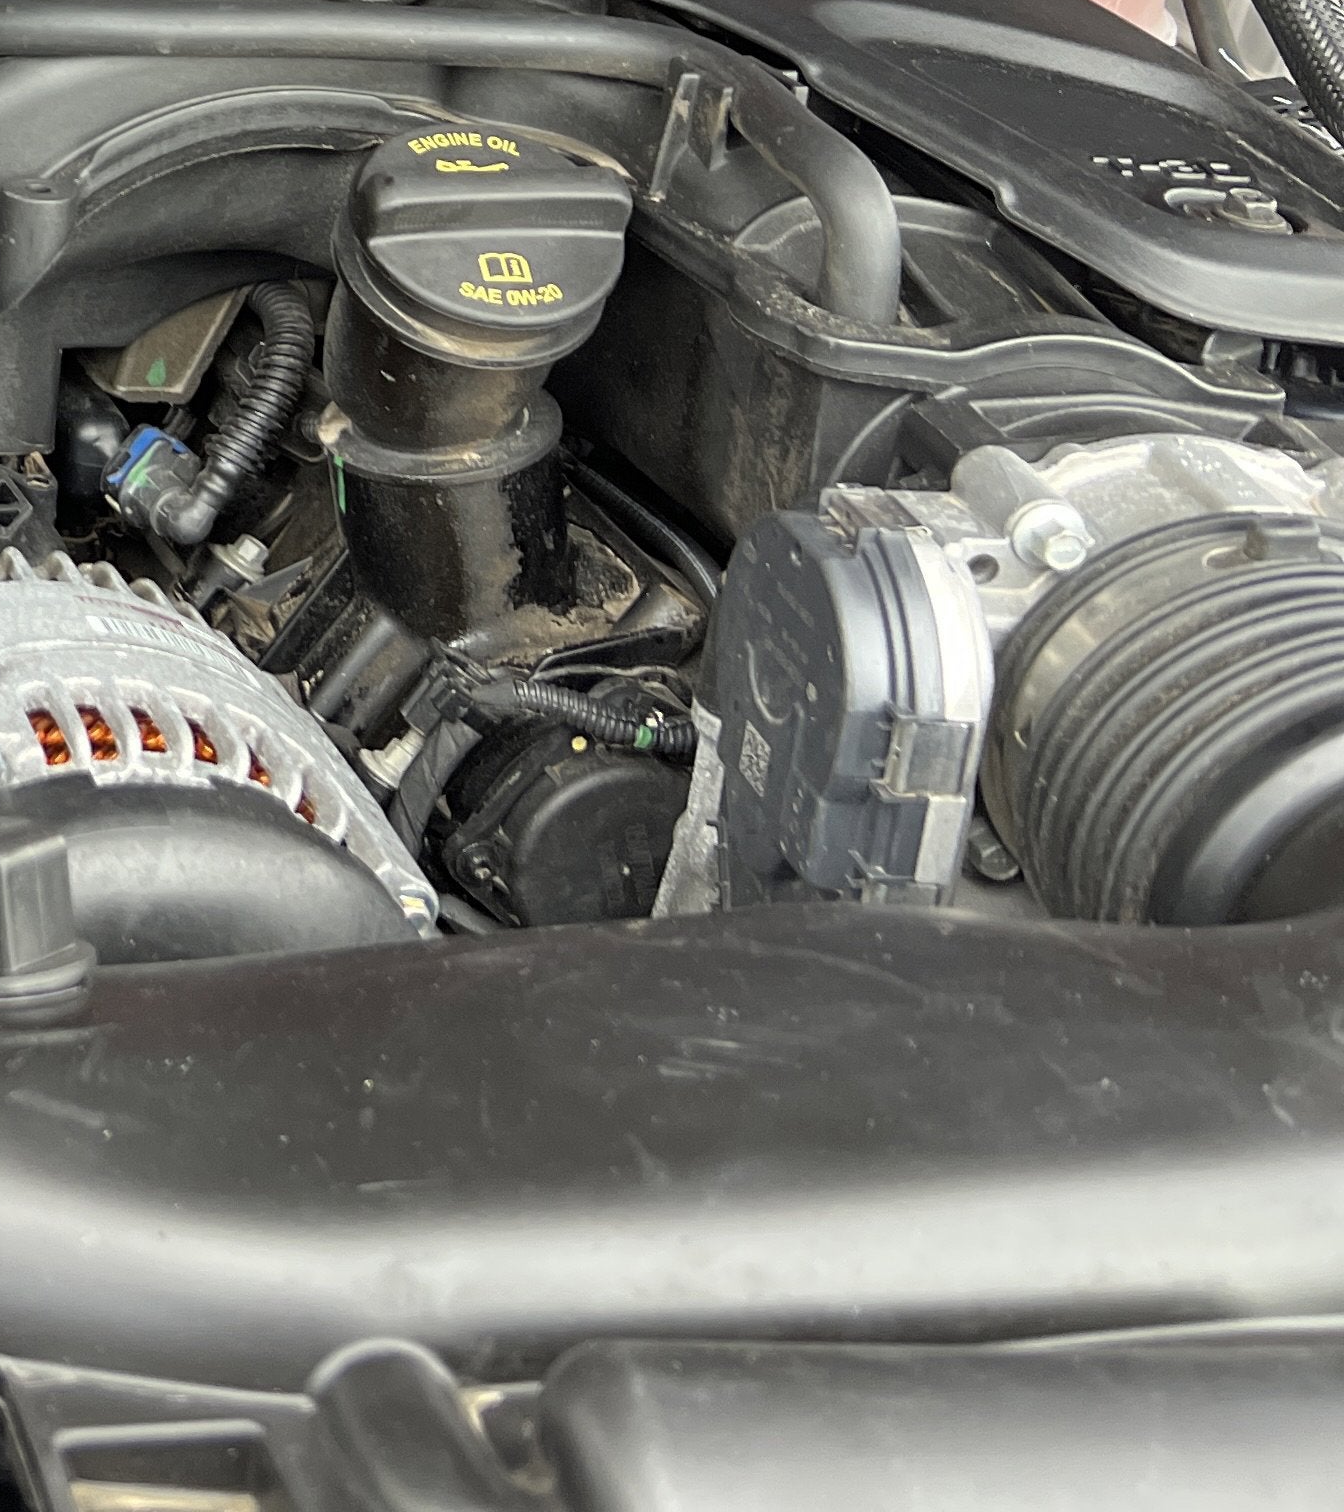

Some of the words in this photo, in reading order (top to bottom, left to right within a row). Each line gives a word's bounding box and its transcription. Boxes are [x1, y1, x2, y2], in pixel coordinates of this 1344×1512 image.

[407, 131, 483, 155] ENGINE
[486, 135, 521, 157] OIL
[458, 281, 504, 305] SAE
[506, 283, 564, 307] 0W-20
